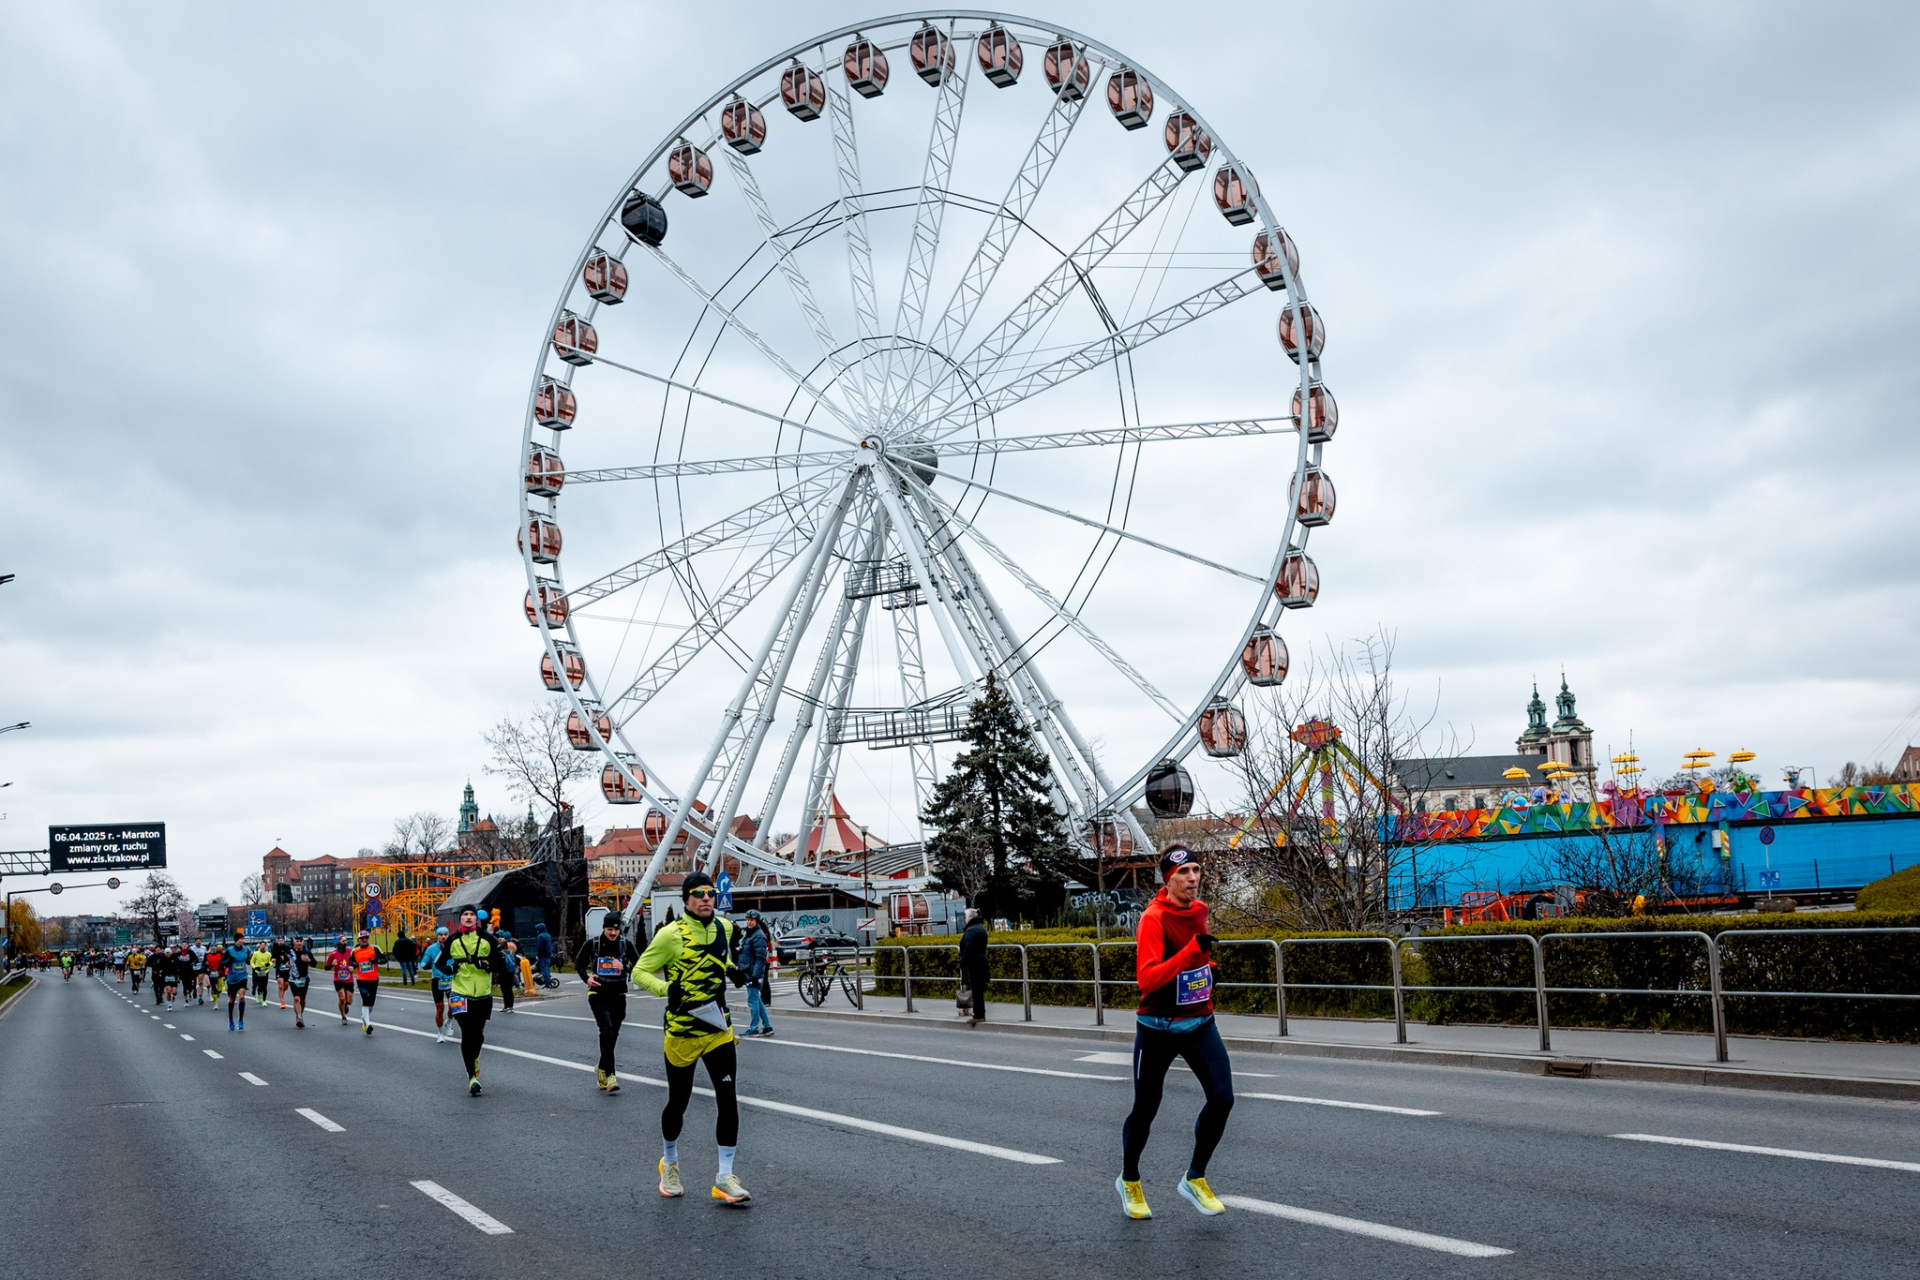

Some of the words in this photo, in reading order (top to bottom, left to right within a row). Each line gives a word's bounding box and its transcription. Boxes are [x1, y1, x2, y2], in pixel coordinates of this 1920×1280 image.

[54, 832, 106, 842] 06.04.2025
[122, 830, 160, 840] Maraton
[69, 843, 102, 853] zmiany
[102, 844, 121, 852] org.
[122, 842, 148, 851] ruchu
[66, 852, 150, 864] www.zis.krakow.pl
[367, 885, 380, 894] 70
[1186, 977, 1208, 991] 1531
